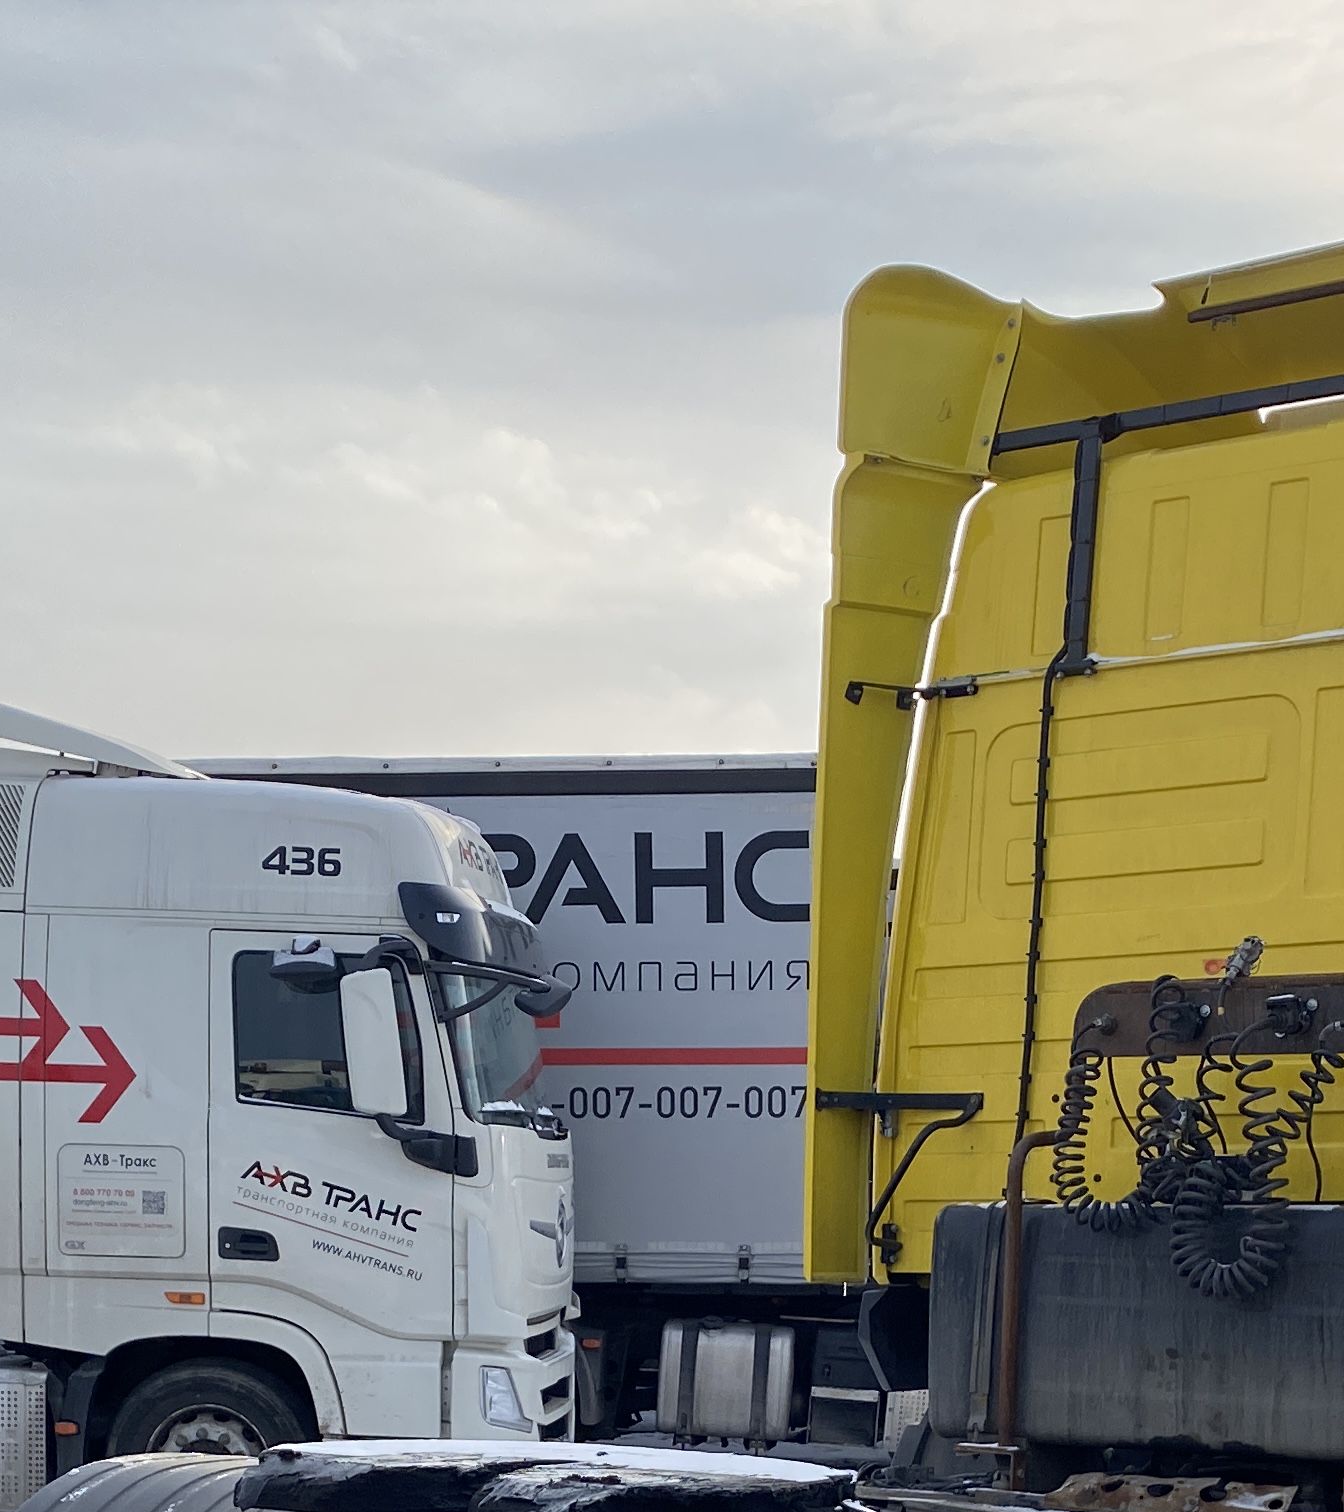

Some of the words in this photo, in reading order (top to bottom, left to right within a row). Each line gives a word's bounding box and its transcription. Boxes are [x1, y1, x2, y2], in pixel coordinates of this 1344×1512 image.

[261, 845, 342, 877] 436
[236, 1185, 338, 1225] транспортная
[342, 1219, 415, 1249] компания
[240, 1160, 313, 1199] АХВ
[321, 1180, 423, 1233] ТРАНС
[311, 1239, 424, 1282] WWW.AHVTRANS.RU
